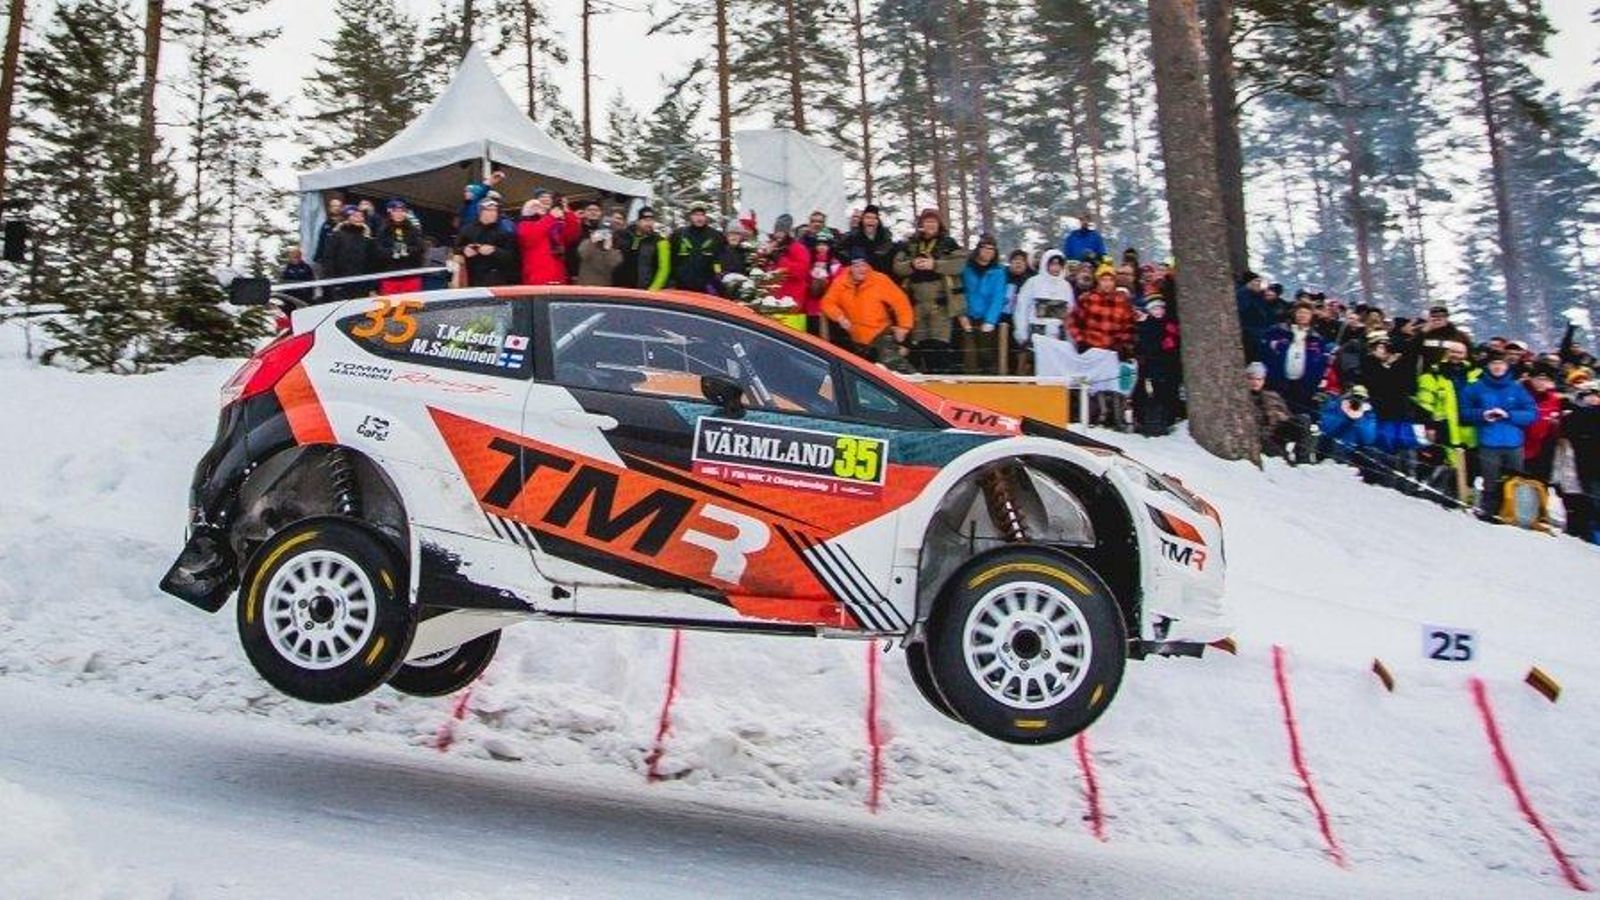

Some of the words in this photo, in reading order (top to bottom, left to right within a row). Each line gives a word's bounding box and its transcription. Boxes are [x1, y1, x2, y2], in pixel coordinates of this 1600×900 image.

[351, 299, 424, 344] 35
[436, 324, 502, 347] T.Katsuta
[410, 338, 497, 365] M.Salminen
[334, 361, 393, 375] TOMMI
[356, 424, 389, 442] Cars!
[704, 426, 835, 469] VÄRMLAND
[834, 436, 878, 481] 35
[480, 436, 771, 586] TMR
[1160, 536, 1206, 572] TMR
[1430, 631, 1473, 662] 25
